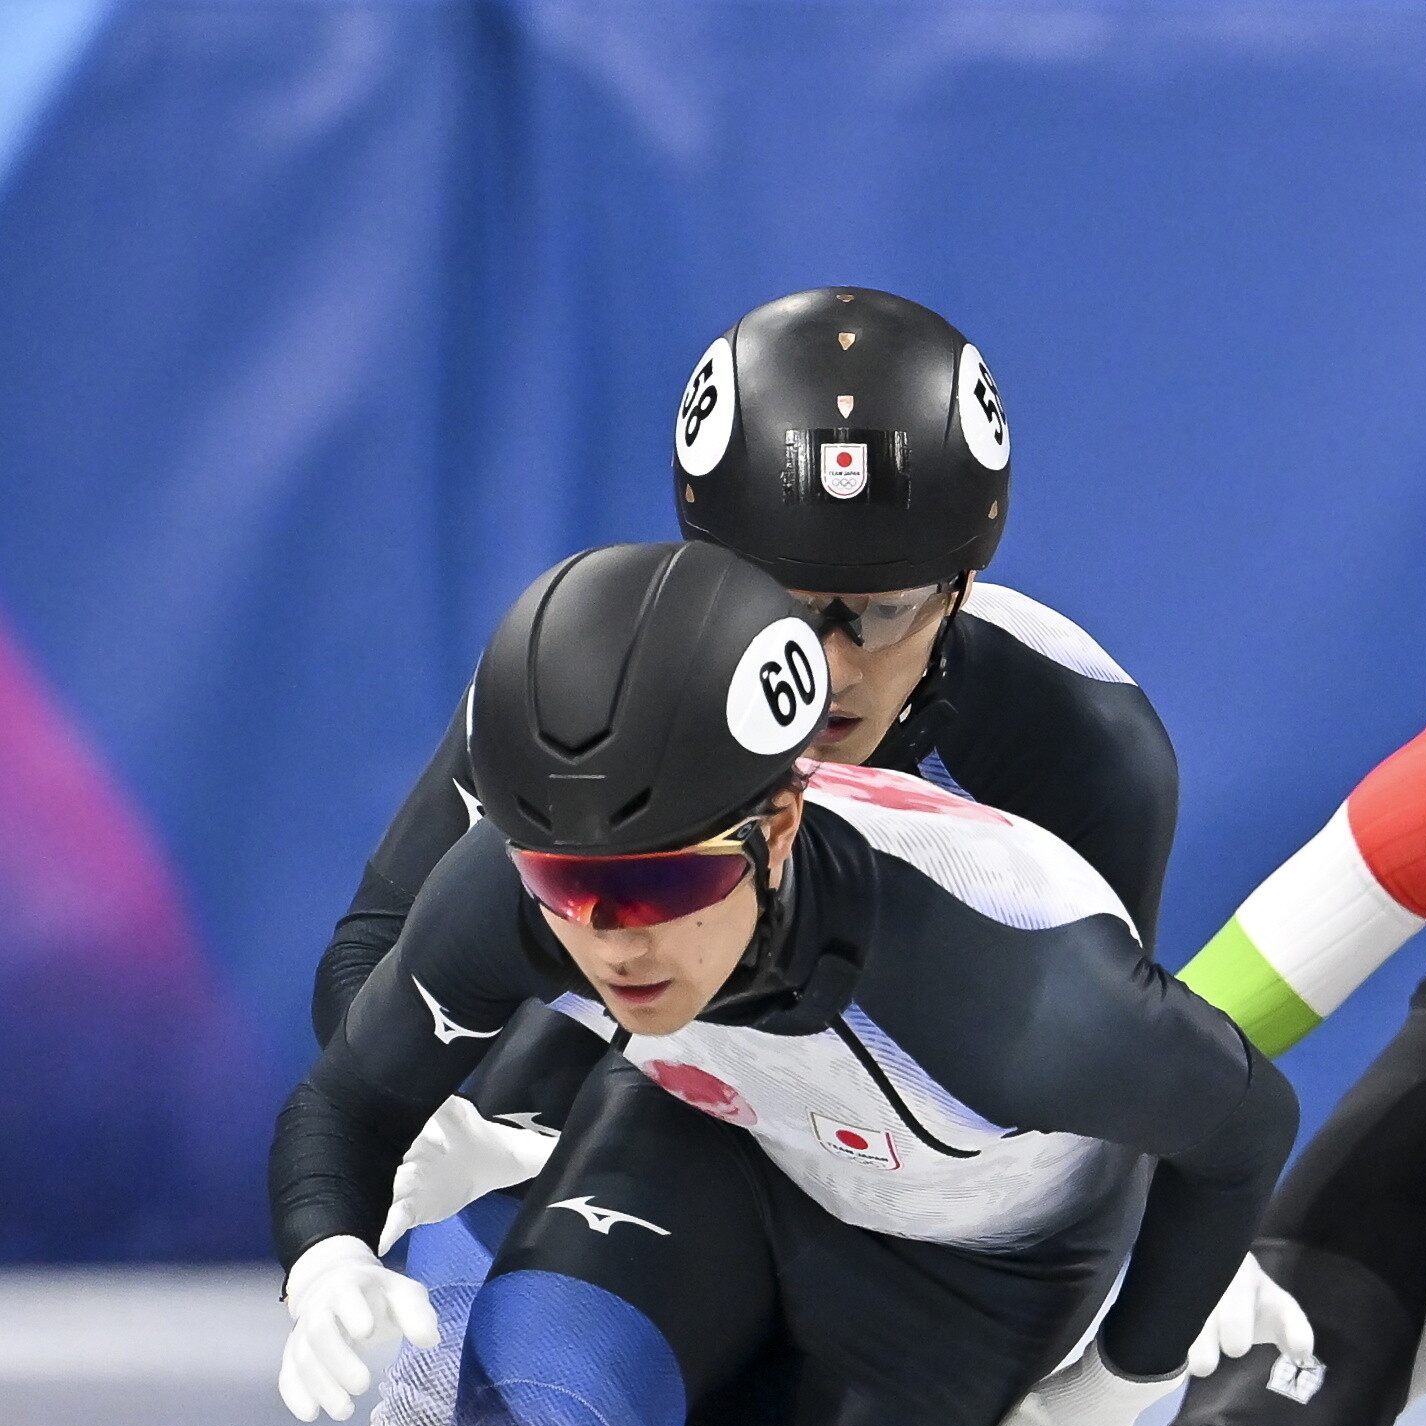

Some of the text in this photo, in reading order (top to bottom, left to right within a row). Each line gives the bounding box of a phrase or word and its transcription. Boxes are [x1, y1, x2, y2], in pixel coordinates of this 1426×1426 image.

[682, 358, 718, 448] 58
[974, 361, 1007, 446] 58
[759, 640, 816, 727] 60
